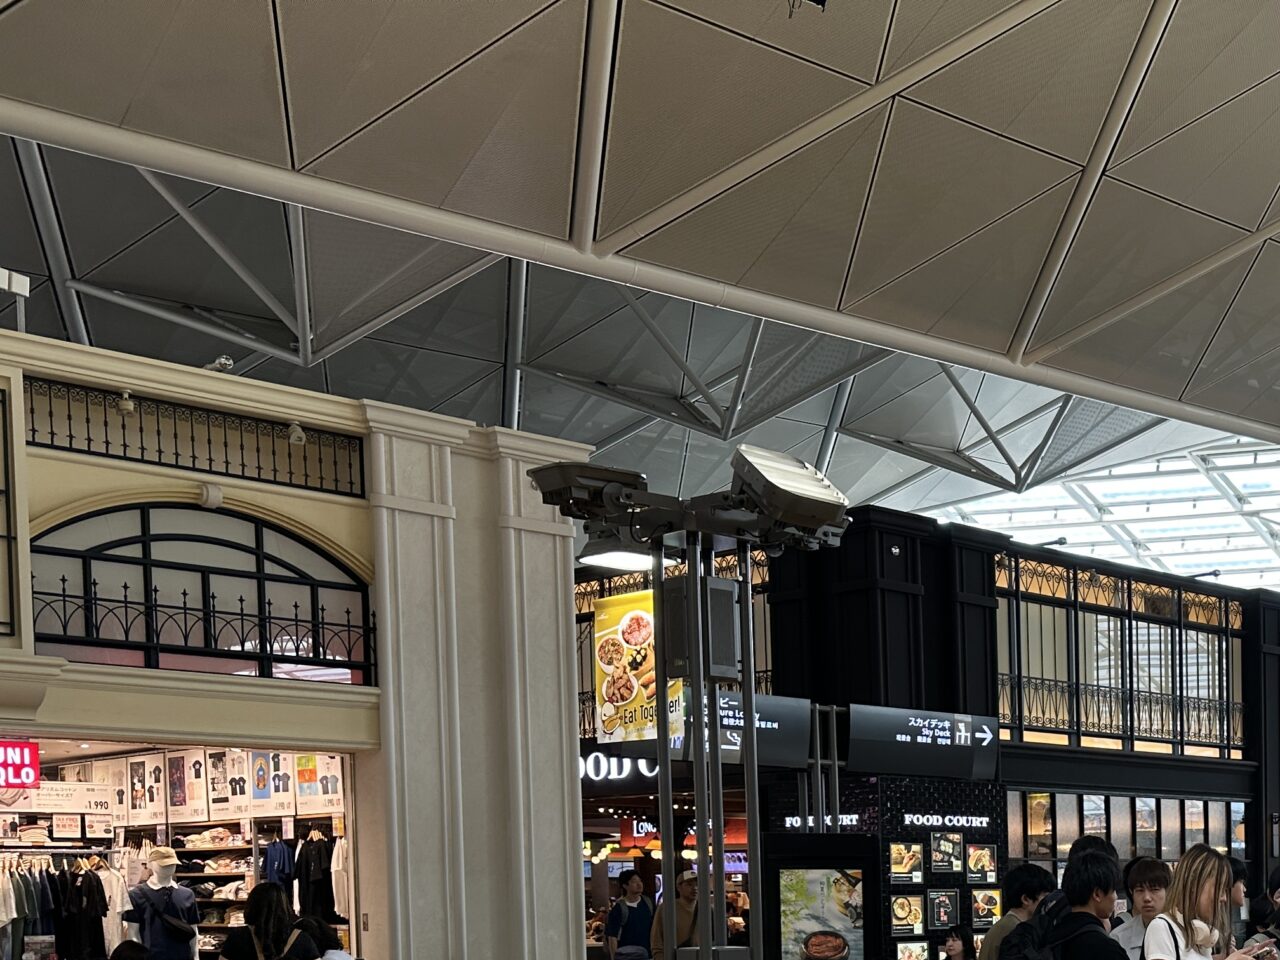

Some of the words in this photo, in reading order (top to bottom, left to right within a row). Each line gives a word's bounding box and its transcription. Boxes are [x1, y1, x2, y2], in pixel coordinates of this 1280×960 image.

[624, 707, 637, 725] Eat
[640, 697, 680, 722] Togeer!
[908, 717, 951, 729] スカイデッキ
[922, 728, 934, 737] Sky
[935, 729, 951, 737] Deck
[785, 816, 814, 828] FOD
[904, 814, 942, 826] FOOD
[944, 815, 989, 827] COURT
